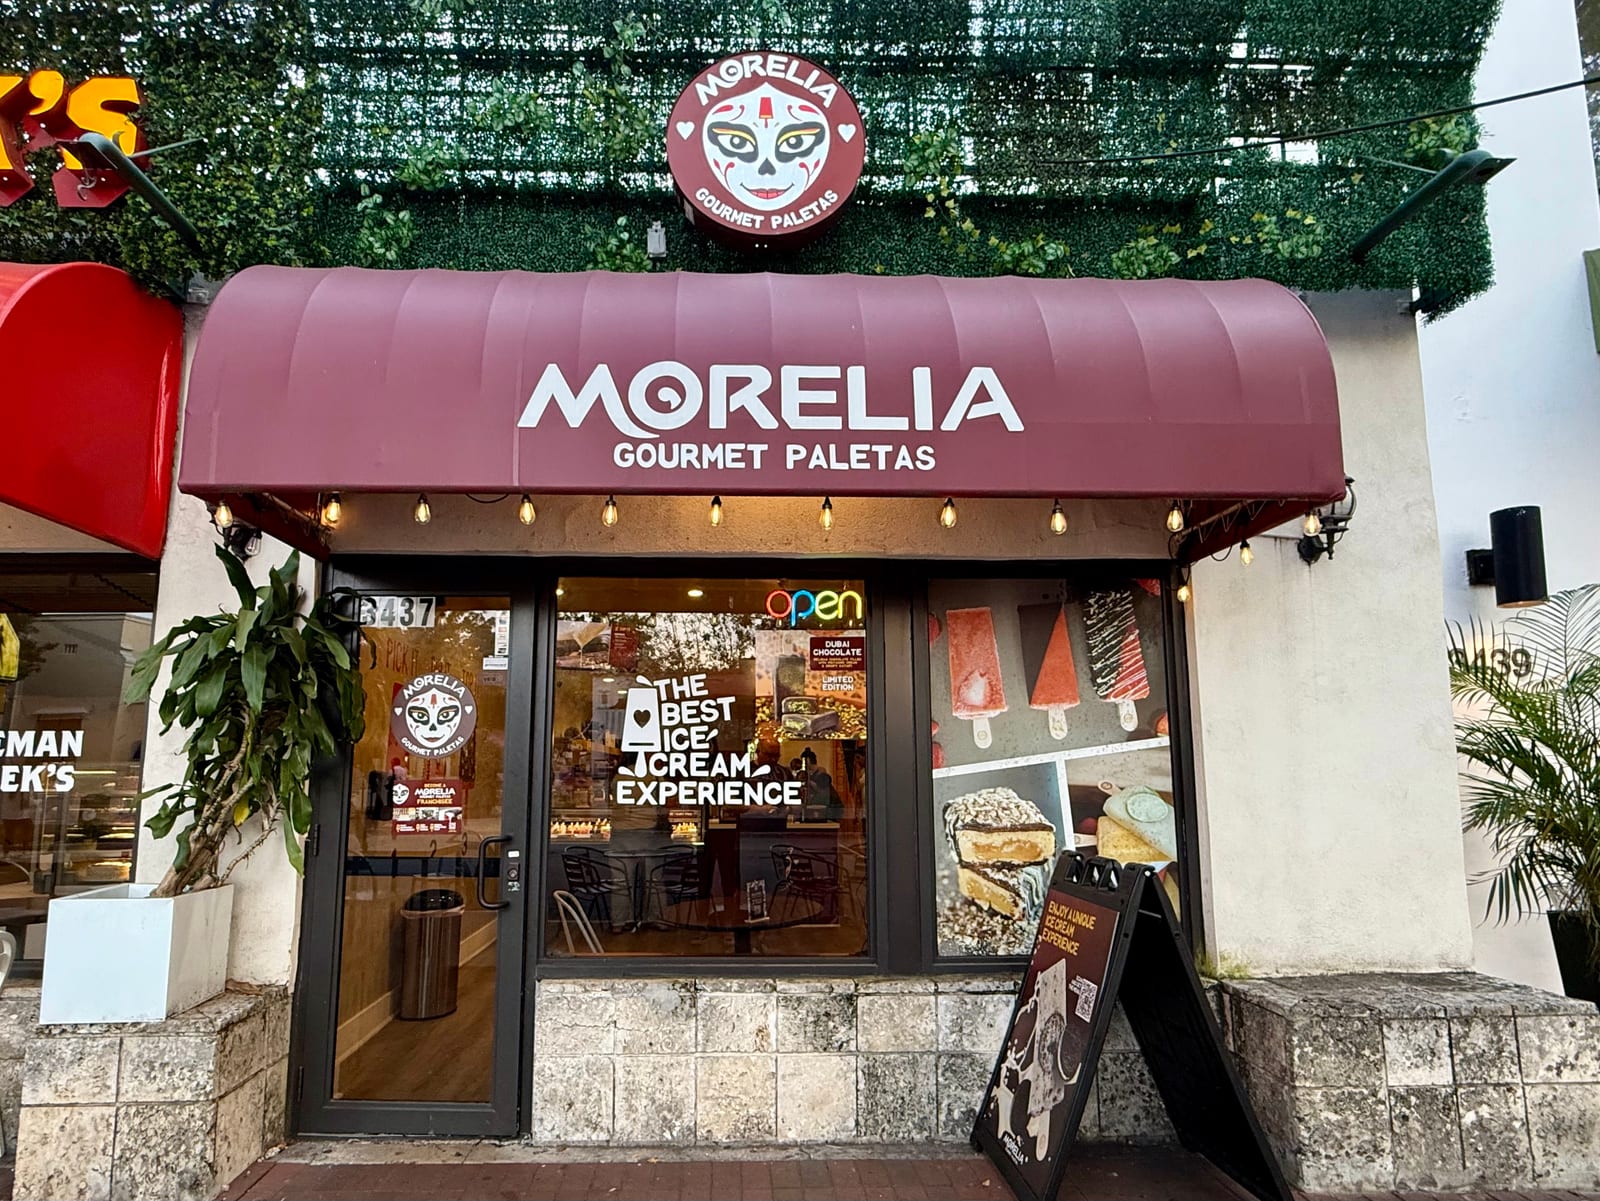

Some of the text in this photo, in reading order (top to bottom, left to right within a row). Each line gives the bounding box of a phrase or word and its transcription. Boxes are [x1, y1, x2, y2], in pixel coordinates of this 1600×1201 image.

[694, 54, 839, 109] MORELIA
[695, 187, 839, 230] GOURMET PALETAS
[516, 360, 1025, 439] MORELIA
[613, 442, 937, 472] GOURMET PALETAS
[765, 588, 864, 628] open
[812, 648, 863, 656] CHOCOLATE
[825, 640, 850, 648] DUBAI
[402, 674, 466, 700] MORELIA
[653, 673, 709, 701] THE
[822, 675, 854, 683] LIMITED
[822, 683, 854, 691] EDITION
[660, 696, 736, 726] BEST
[401, 735, 465, 756] GOURMET PALETAS
[663, 725, 711, 751] ICE
[648, 751, 751, 778] CREAM
[414, 787, 456, 796] MORELIA
[615, 780, 803, 806] EXPERIENCE
[1044, 914, 1076, 939] ICE CREAM
[1042, 927, 1080, 956] EXPERIENCE
